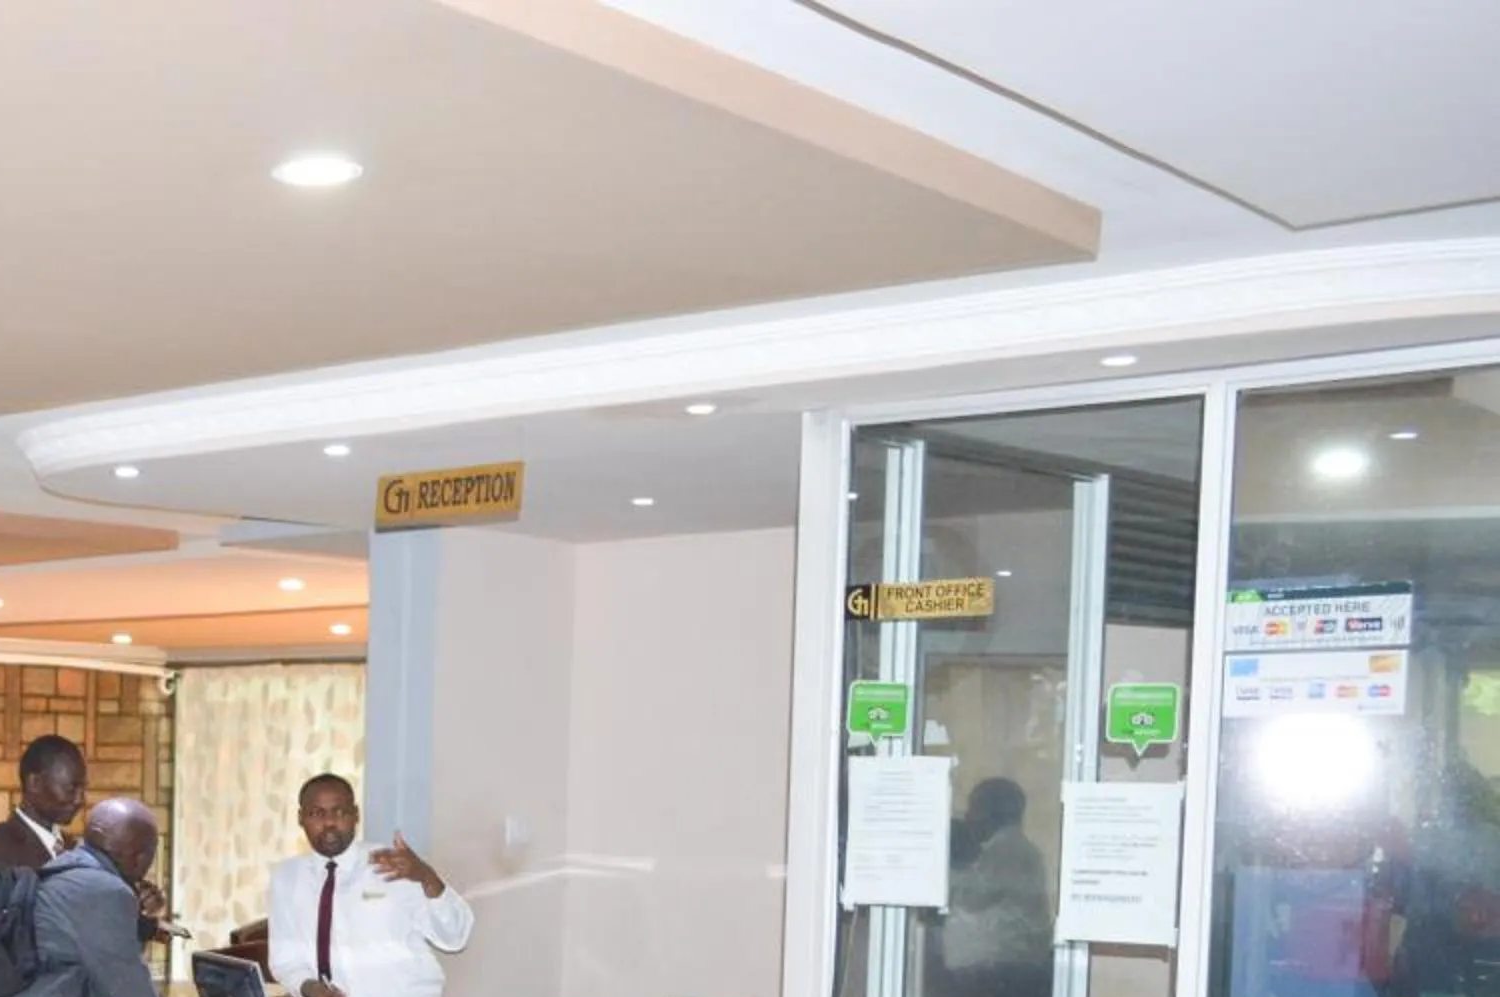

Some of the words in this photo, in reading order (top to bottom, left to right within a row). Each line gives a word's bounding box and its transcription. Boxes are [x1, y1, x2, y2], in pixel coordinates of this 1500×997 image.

[417, 471, 517, 510] RECEPTION
[887, 585, 932, 600] FRONT
[935, 582, 986, 599] OFFICE
[905, 598, 965, 613] CASHIER
[1264, 603, 1332, 617] ACCEPTED
[1334, 600, 1372, 613] HERE
